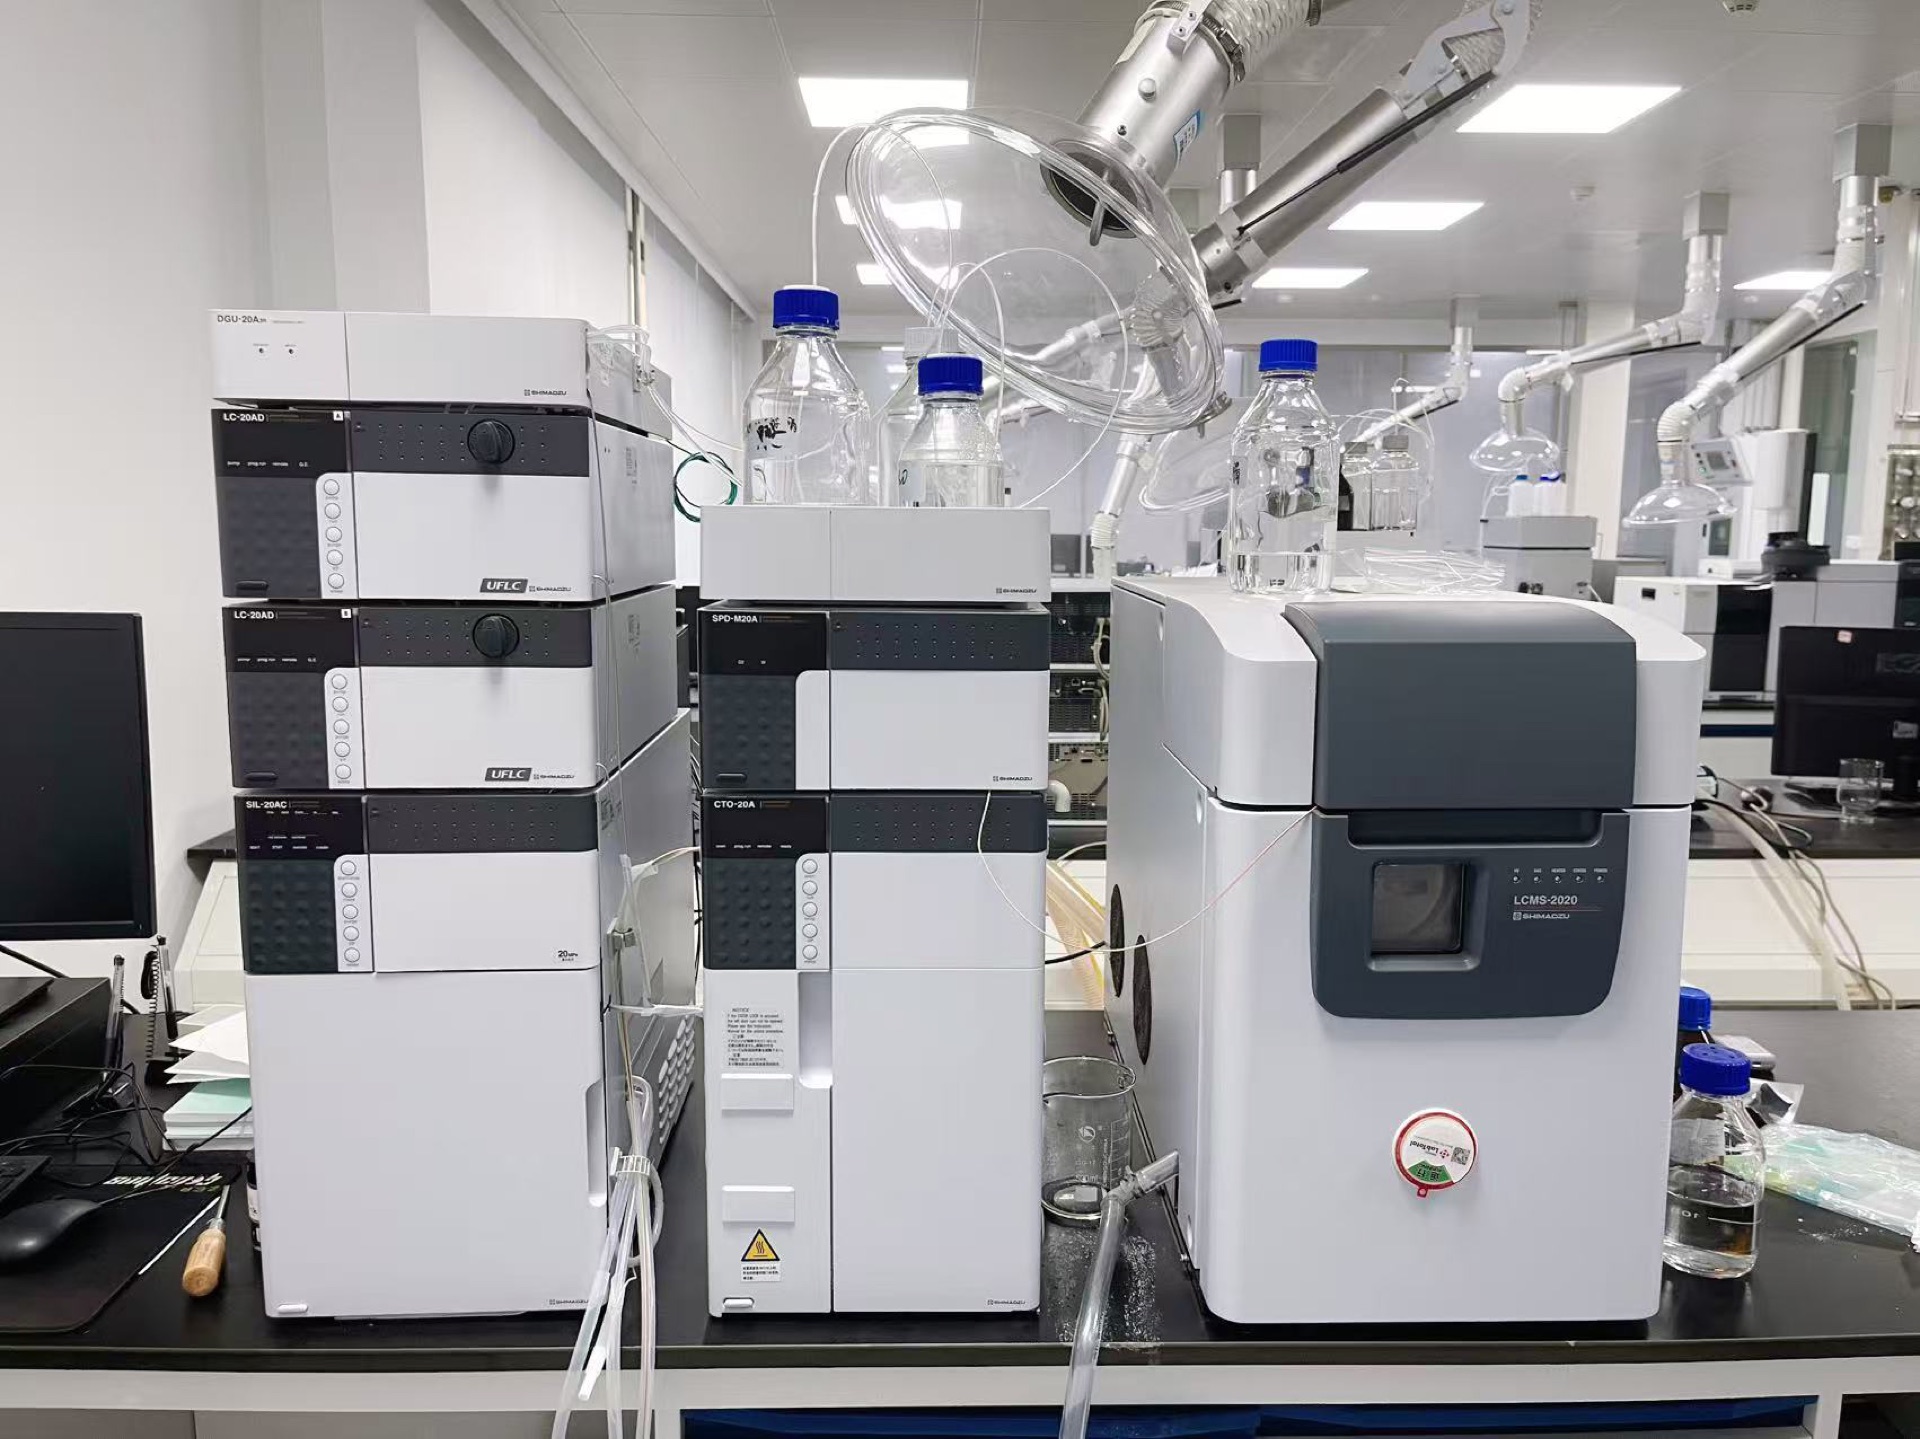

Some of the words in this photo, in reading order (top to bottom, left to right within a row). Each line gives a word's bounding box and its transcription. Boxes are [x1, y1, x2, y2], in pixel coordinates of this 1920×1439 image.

[223, 413, 265, 422] LC-20AD
[486, 581, 522, 591] UFLC
[234, 610, 275, 619] LC-20AD
[712, 614, 758, 623] SPD-M20A
[491, 769, 527, 779] UFLC
[246, 801, 288, 809] SIL-20AC
[713, 800, 756, 809] CTO-20A
[1514, 895, 1578, 905] LCMS-2020
[1409, 1140, 1439, 1153] LabTotal
